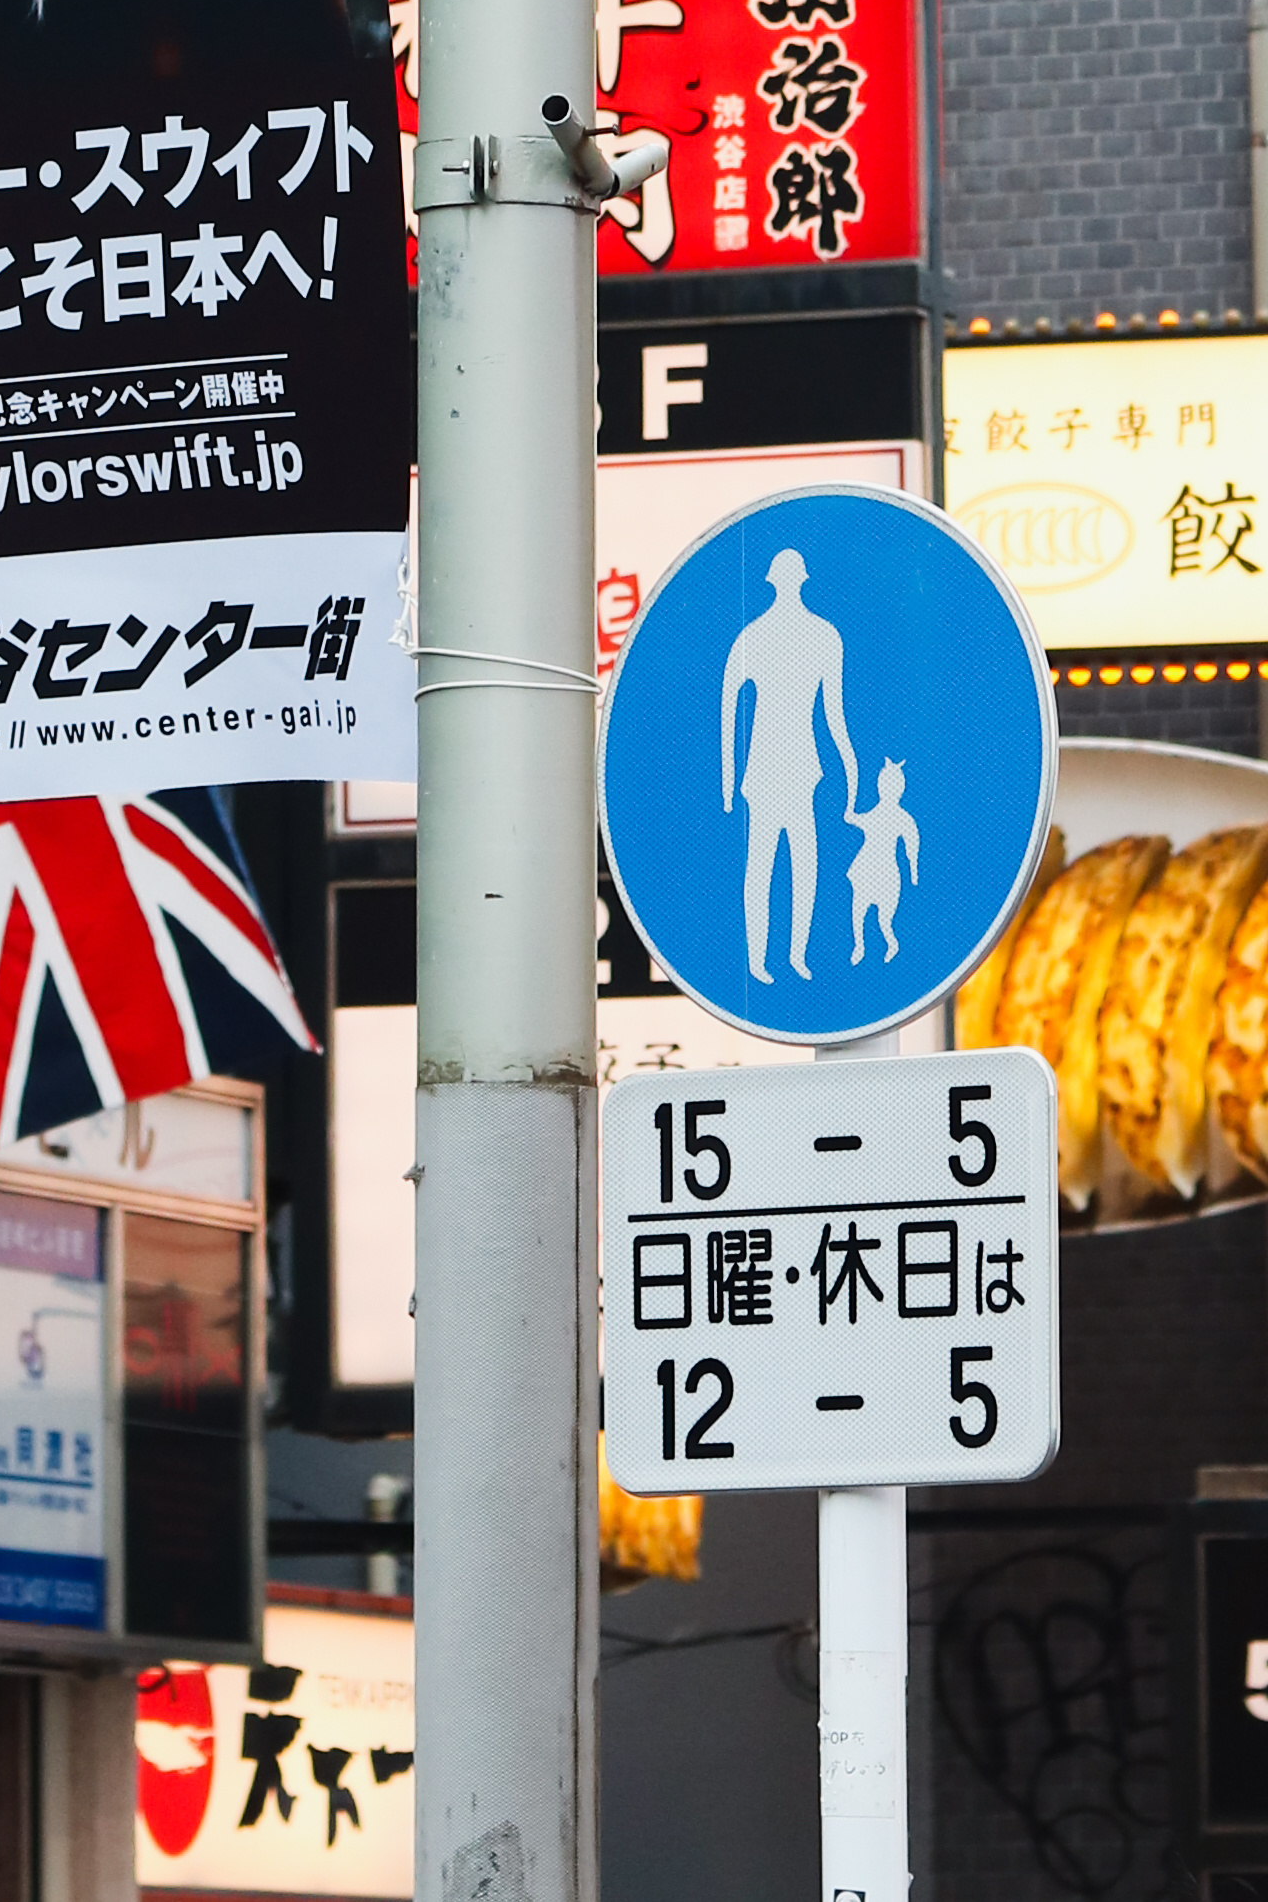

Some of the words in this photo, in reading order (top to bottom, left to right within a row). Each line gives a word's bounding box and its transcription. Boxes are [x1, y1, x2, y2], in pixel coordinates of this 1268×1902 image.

[1158, 481, 1262, 579] 餃
[654, 1099, 731, 1203] 15
[948, 1084, 997, 1187] 5
[633, 1220, 1026, 1330] 日曜・休日は
[657, 1357, 734, 1461] 12
[948, 1345, 998, 1449] 5
